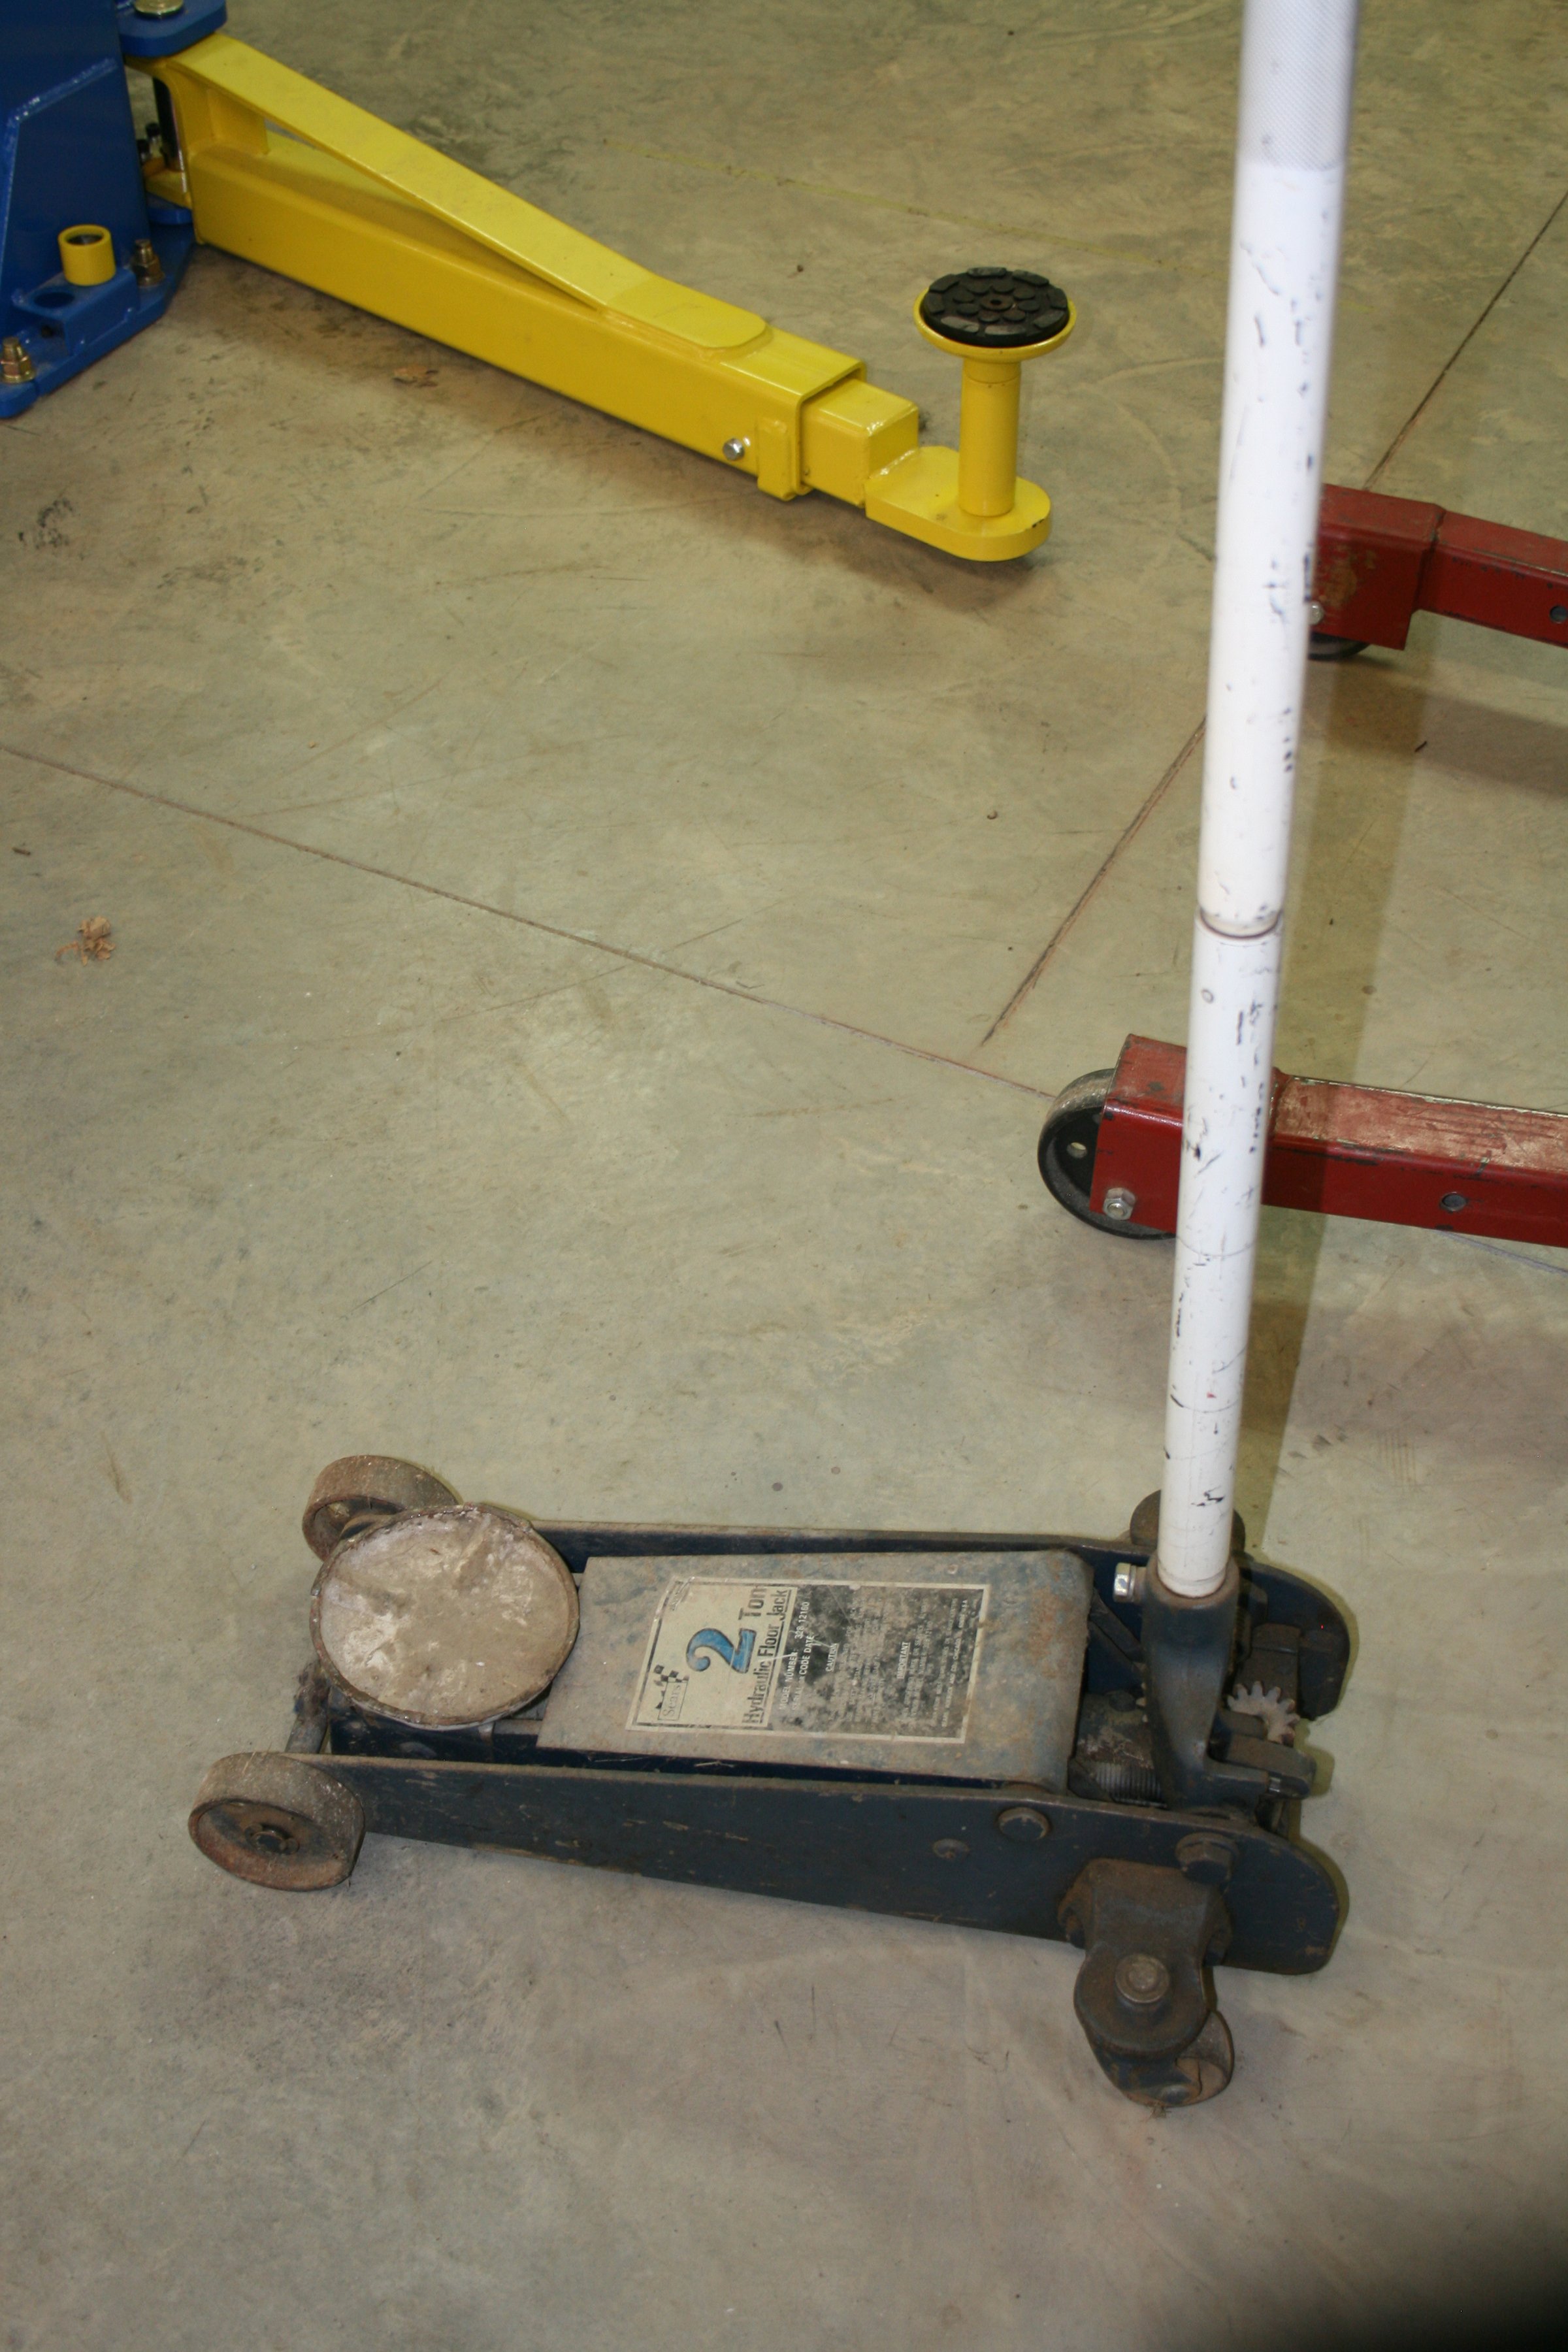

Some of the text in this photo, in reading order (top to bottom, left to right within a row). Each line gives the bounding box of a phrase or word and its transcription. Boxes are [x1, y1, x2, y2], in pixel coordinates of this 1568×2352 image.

[686, 1586, 764, 1673] 2 Ton
[742, 1589, 789, 1723] Hydraulic Floor Jack
[798, 1655, 811, 1674] CODE
[825, 1642, 838, 1671] CAUTION
[895, 1641, 908, 1678] IMPORTANT
[663, 1685, 681, 1716] Sears
[779, 1685, 791, 1709] MODEL
